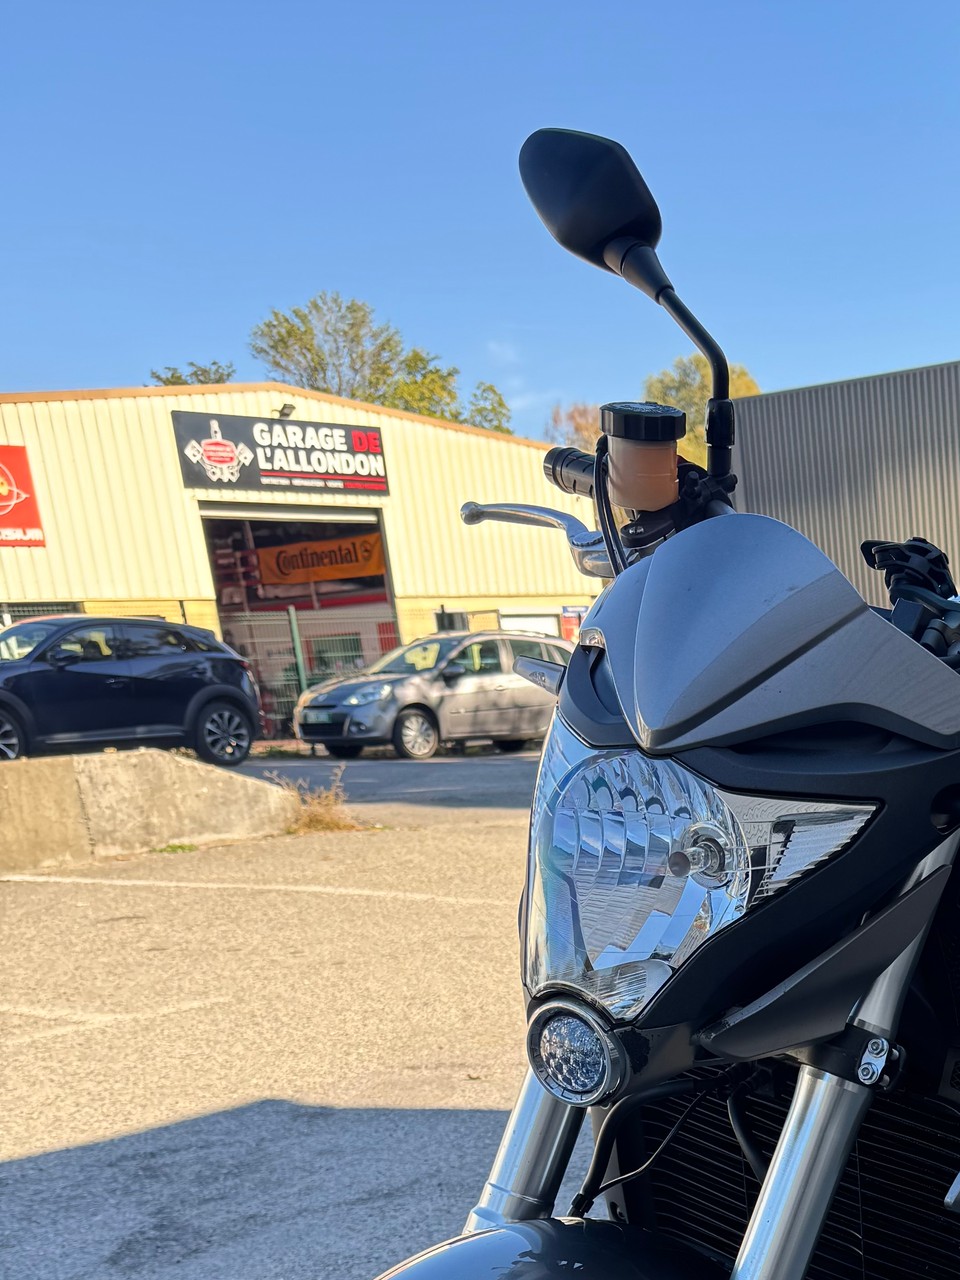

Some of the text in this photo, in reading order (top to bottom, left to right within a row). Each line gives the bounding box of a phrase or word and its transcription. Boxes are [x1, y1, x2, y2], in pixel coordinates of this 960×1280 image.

[252, 422, 381, 453] GARAGE DE
[256, 447, 385, 476] L'ALLONDON
[276, 542, 359, 576] Continental
